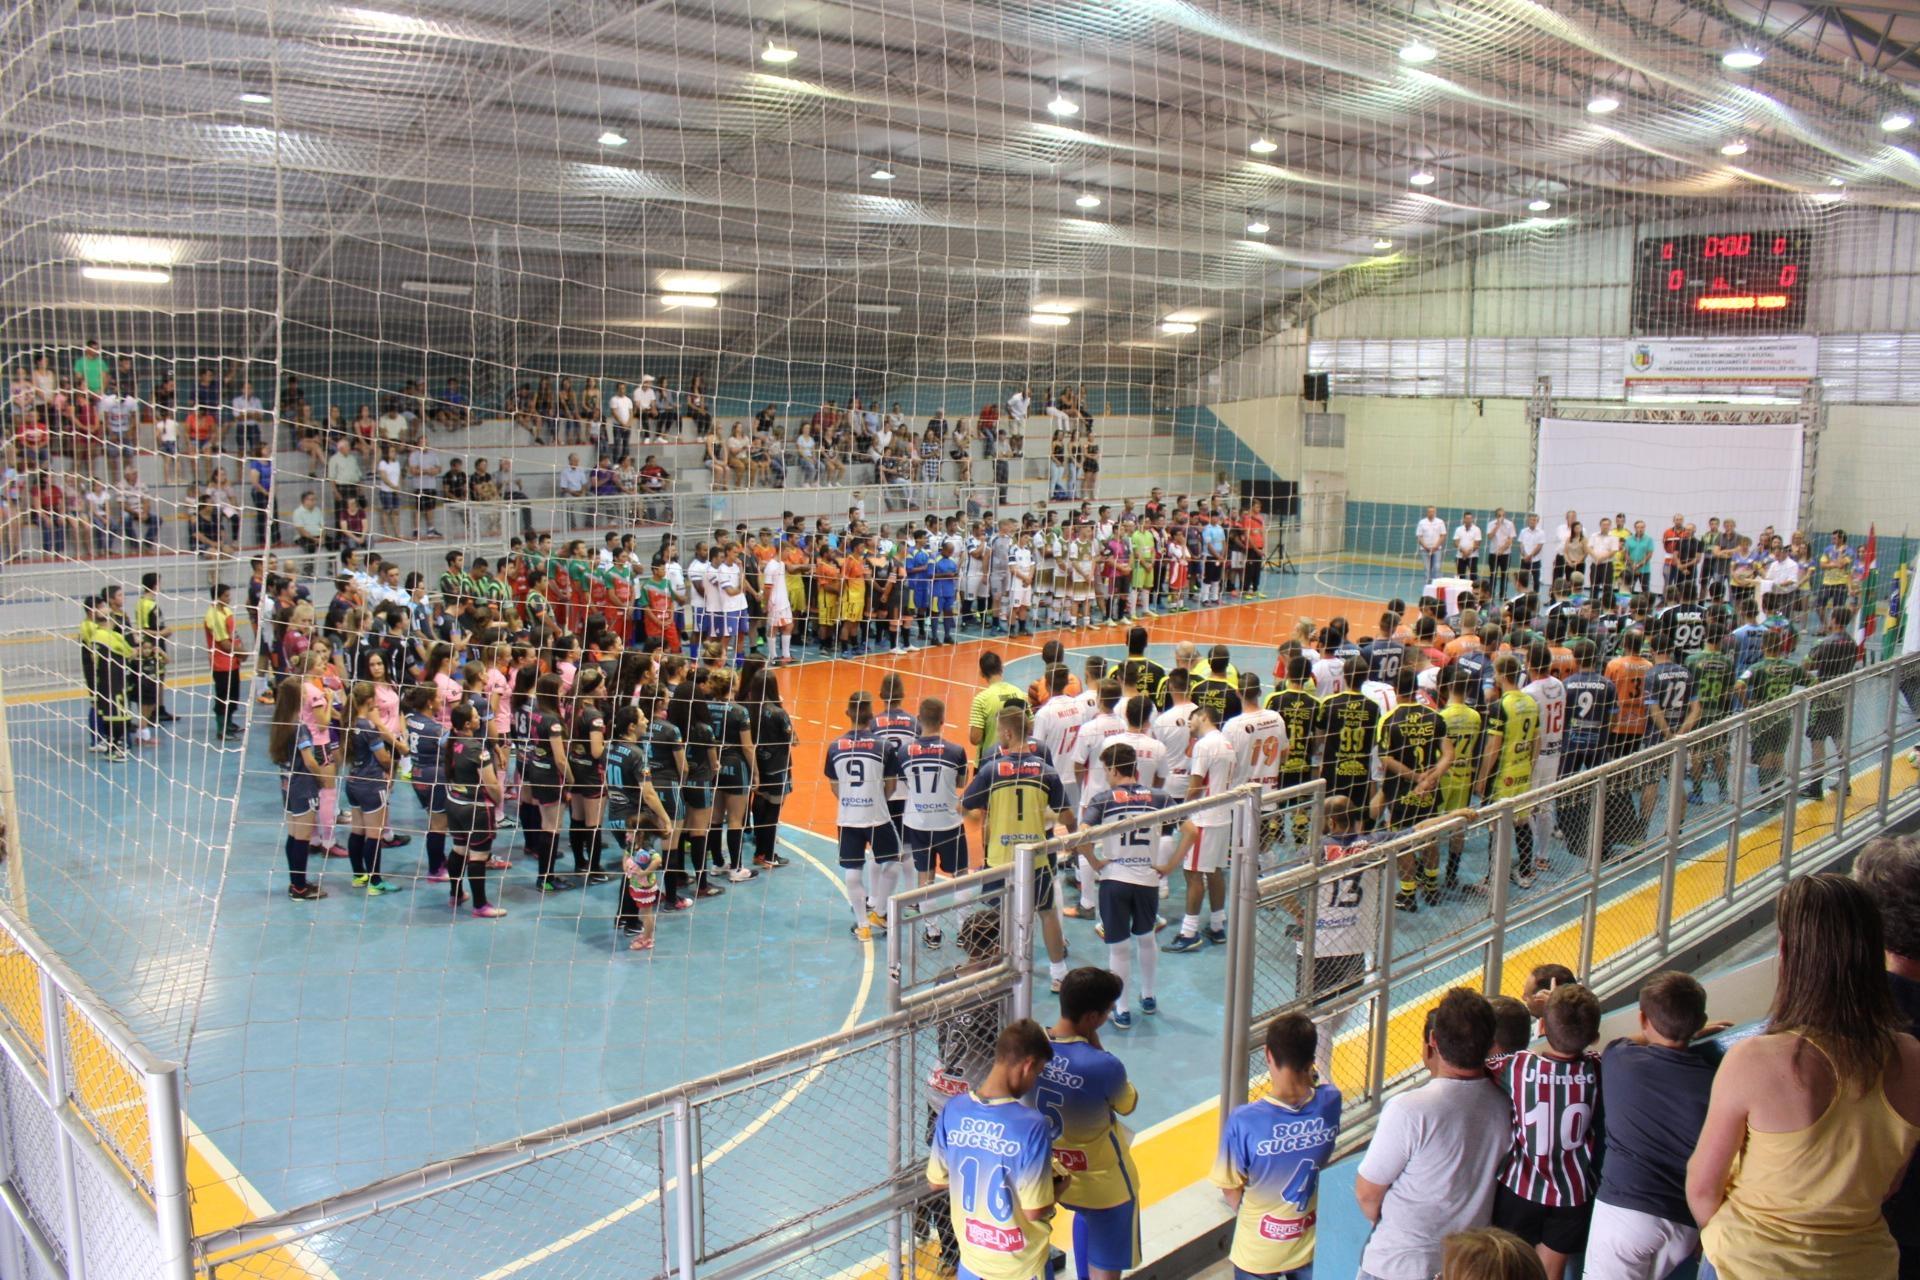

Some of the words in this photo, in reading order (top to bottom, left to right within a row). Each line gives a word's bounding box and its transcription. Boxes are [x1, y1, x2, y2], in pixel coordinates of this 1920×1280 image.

[1668, 269, 1684, 290] 0
[1779, 265, 1798, 287] 0
[1674, 625, 1705, 647] 99
[1378, 656, 1399, 679] 10
[1577, 691, 1594, 718] 9
[1662, 681, 1687, 708] 12
[1058, 725, 1081, 756] 17
[1340, 726, 1365, 752] 99
[1521, 718, 1531, 740] 9
[1250, 735, 1280, 767] 19
[846, 759, 865, 787] 9
[911, 766, 942, 793] 17
[1015, 788, 1023, 821] 1
[1039, 1065, 1085, 1089] ESSO
[1036, 1086, 1064, 1141] 5
[961, 1117, 1005, 1139] BOM
[1256, 1124, 1339, 1156] SUCESSO
[1273, 1117, 1325, 1141] BOM
[1524, 1101, 1593, 1156] 10
[947, 1131, 1021, 1157] SUCESSO
[958, 1156, 1014, 1223] 16
[1280, 1158, 1320, 1213] 4
